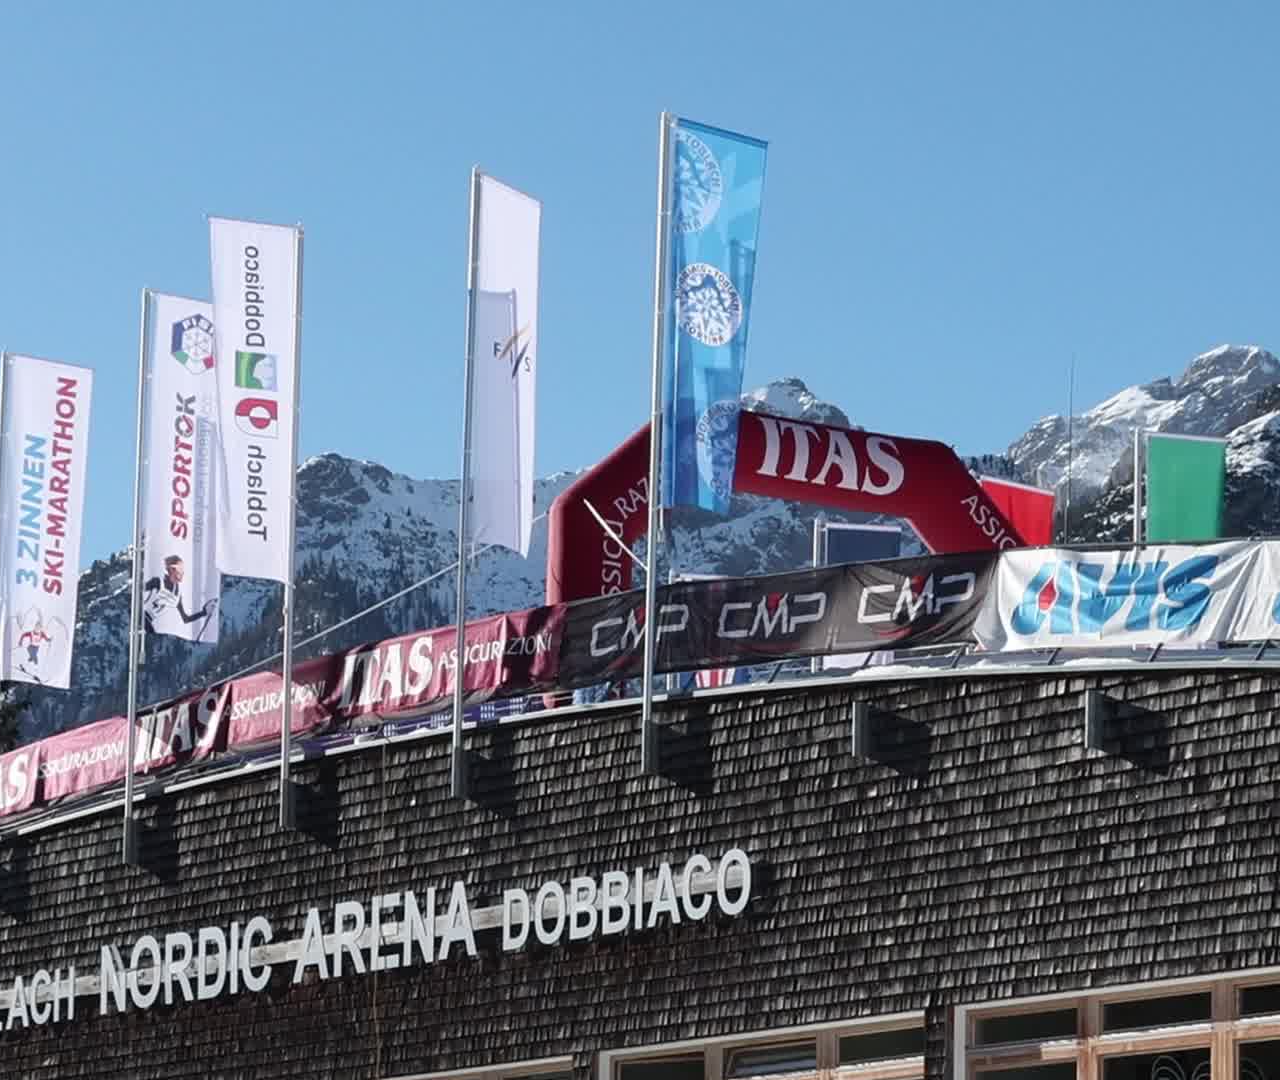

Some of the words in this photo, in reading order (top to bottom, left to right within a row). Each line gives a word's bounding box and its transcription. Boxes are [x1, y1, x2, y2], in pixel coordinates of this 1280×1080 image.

[18, 433, 47, 561] ZINNEN
[43, 376, 78, 596] SKI-MARATHON
[755, 415, 905, 497] ITAS
[16, 566, 39, 588] 3
[715, 591, 826, 641] CMP
[856, 570, 976, 625] CMP
[1012, 555, 1219, 638] AVIS
[336, 636, 434, 713] ITAS
[99, 916, 274, 1015] NORDIC
[293, 881, 479, 985] ARENA
[502, 848, 752, 951] DOBBIACO
